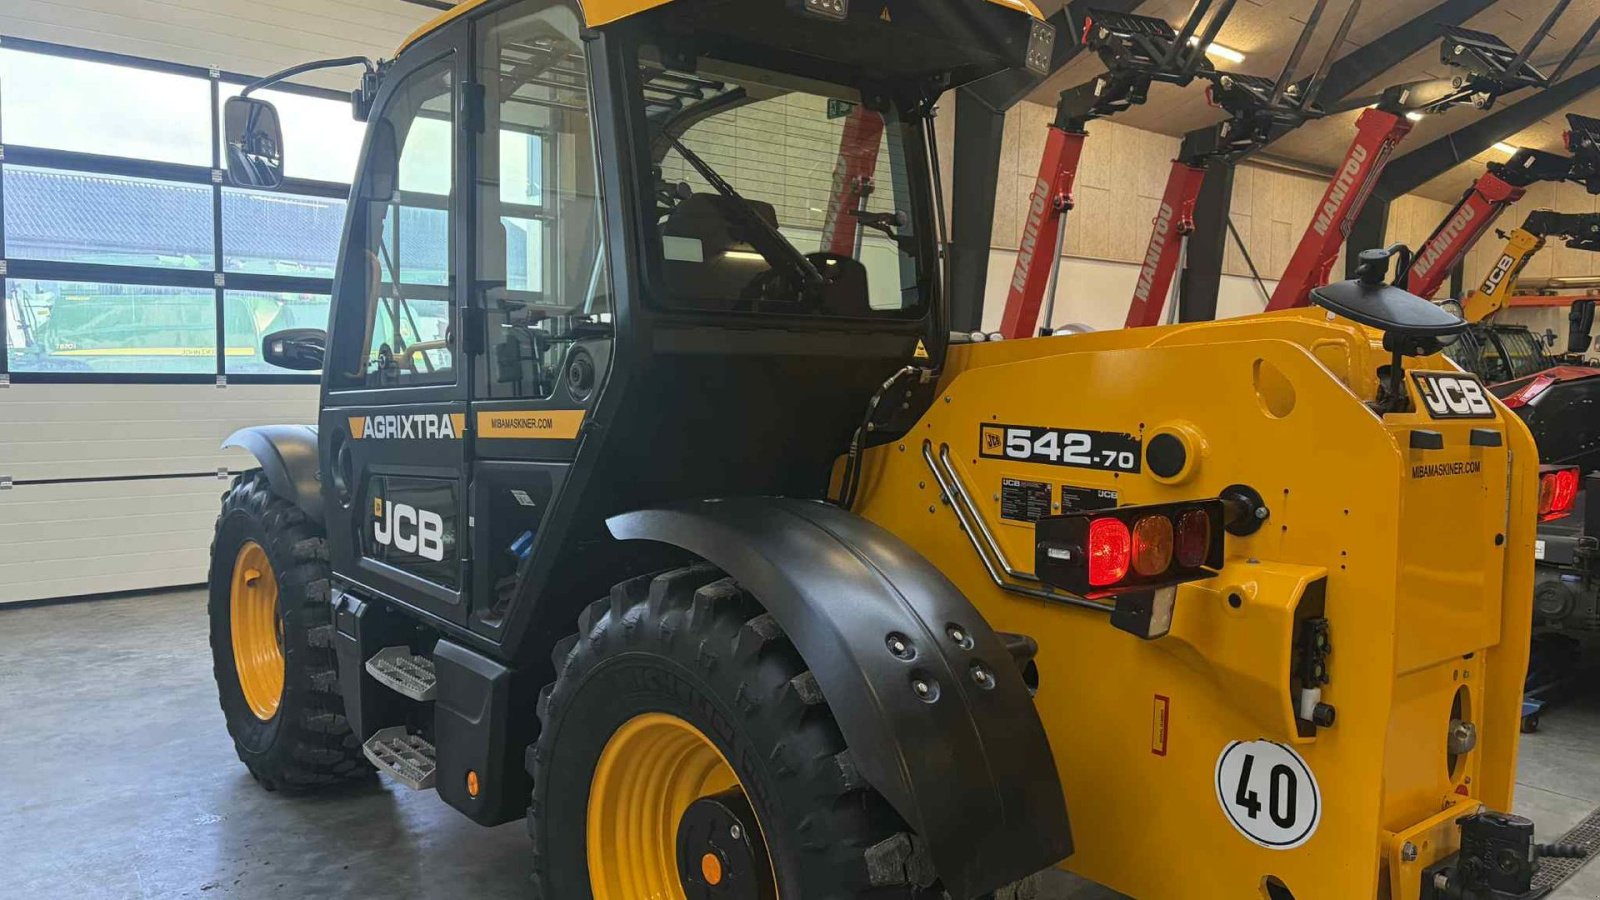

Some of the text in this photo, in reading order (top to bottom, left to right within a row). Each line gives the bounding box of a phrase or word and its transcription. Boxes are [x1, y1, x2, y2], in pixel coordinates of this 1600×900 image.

[1313, 144, 1368, 237] MANITOU
[1011, 178, 1050, 294] MANITOU
[1135, 202, 1174, 303] MANITOU
[1414, 205, 1476, 278] MANITOU
[1486, 255, 1514, 295] JCB
[1425, 377, 1493, 415] JCB
[363, 413, 455, 439] AGRIXTRA
[491, 418, 553, 429] MIBAMASKINER.COM
[1003, 479, 1020, 487] JCB
[1412, 461, 1481, 479] MIBAMASKINER.COM
[1098, 490, 1118, 499] JCB
[374, 500, 444, 562] JCB
[1235, 753, 1298, 829] 40
